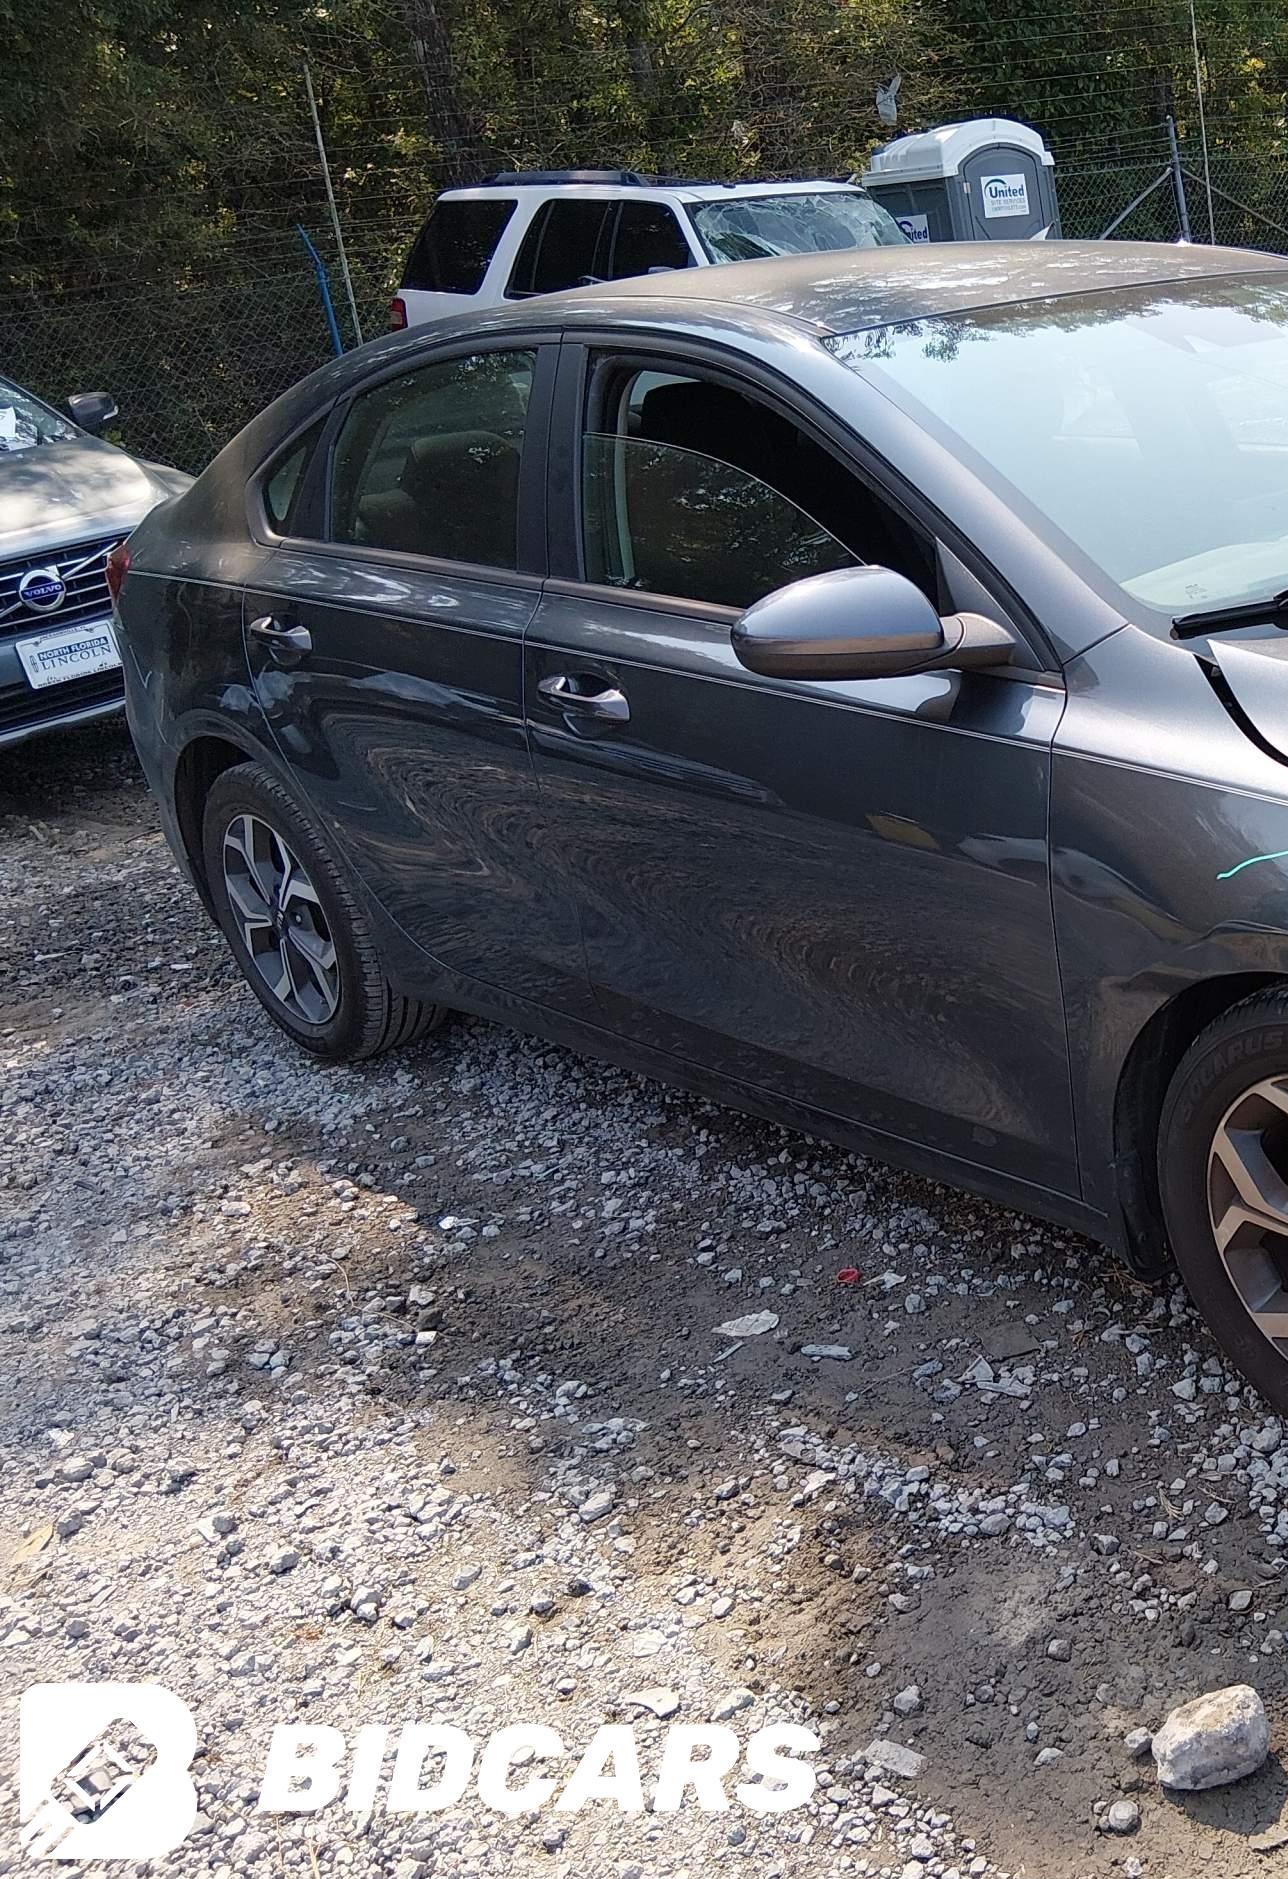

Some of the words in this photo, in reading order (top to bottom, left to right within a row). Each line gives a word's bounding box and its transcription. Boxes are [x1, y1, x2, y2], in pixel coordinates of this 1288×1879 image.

[988, 184, 1025, 199] United
[905, 226, 928, 241] ited
[23, 584, 62, 598] VOLVO
[39, 647, 71, 661] NORTH
[71, 637, 107, 653] FLORIDA
[40, 645, 112, 671] LINCOLN
